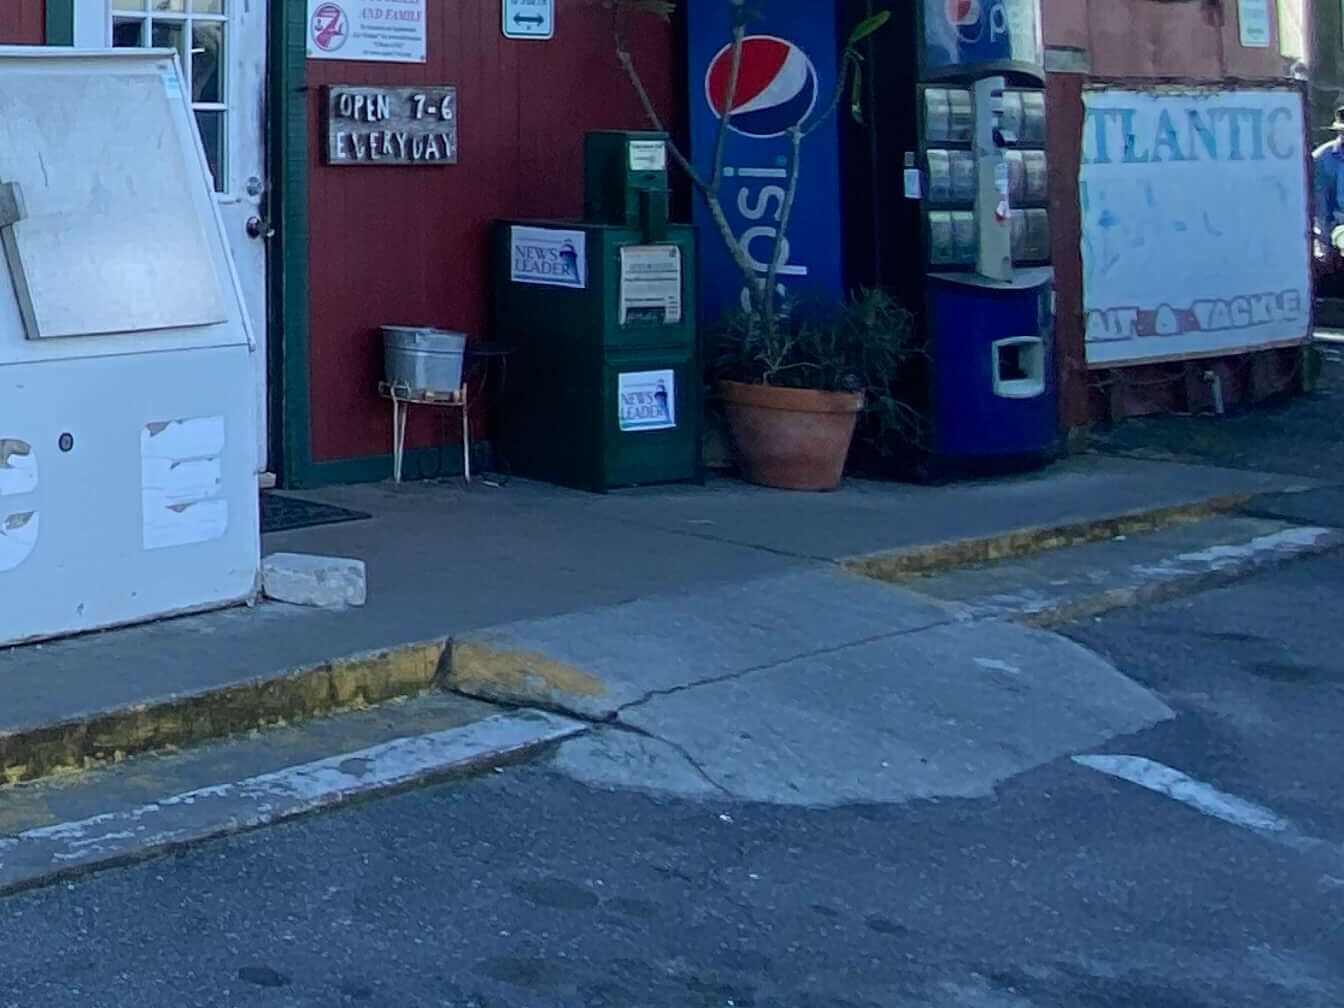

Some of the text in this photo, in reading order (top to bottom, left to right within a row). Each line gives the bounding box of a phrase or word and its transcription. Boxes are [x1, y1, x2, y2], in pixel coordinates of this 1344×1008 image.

[385, 7, 422, 22] FAMILY
[339, 93, 453, 121] OPEN 7-6
[1081, 106, 1296, 164] TLANTIC
[515, 244, 559, 261] NEWS
[515, 258, 571, 276] LEADER
[1191, 288, 1301, 332] TACKLE
[621, 391, 654, 405] NEWS
